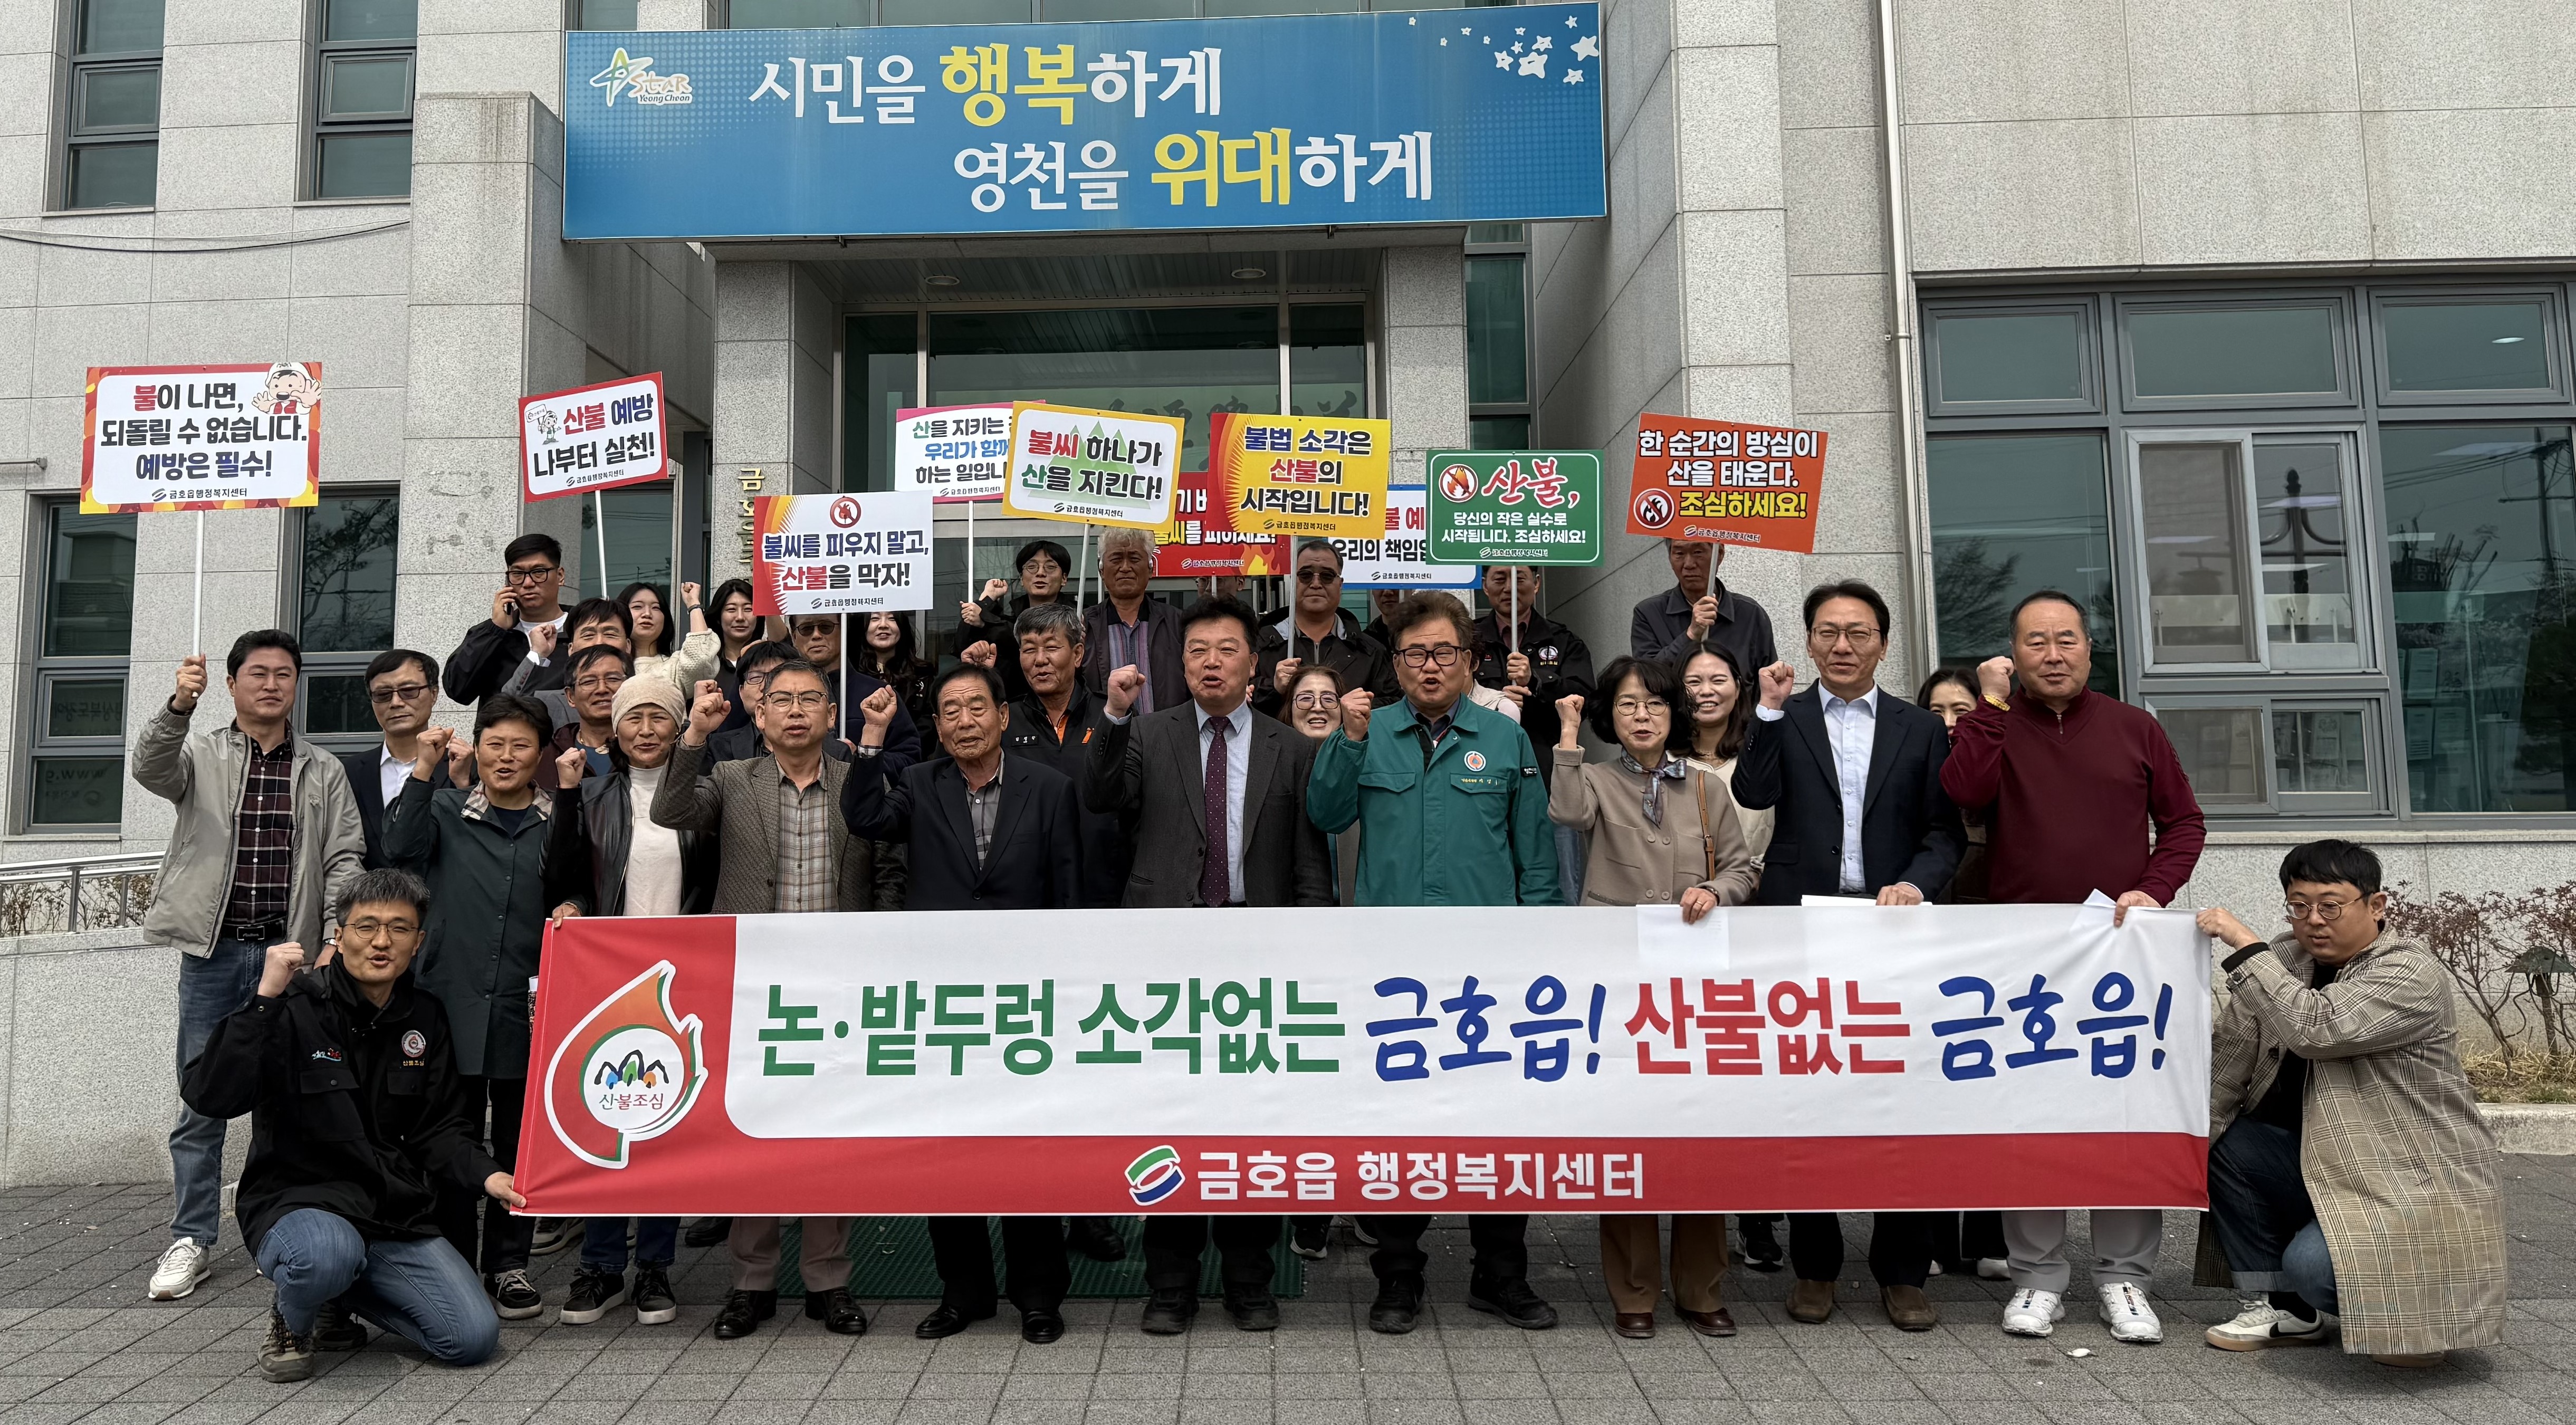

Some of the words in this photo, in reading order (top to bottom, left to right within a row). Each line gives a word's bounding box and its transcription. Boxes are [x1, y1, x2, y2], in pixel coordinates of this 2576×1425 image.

[640, 94, 663, 103] Yeong
[749, 54, 926, 124] 시민을
[940, 42, 1222, 127] 행복하게
[954, 140, 1128, 213] 영천을
[1152, 127, 1432, 206] 위대하게
[134, 384, 180, 411] 불이
[188, 382, 243, 413] 나면,
[563, 403, 606, 435] 산불
[611, 394, 654, 426] 예방
[913, 420, 947, 438] 산을
[952, 417, 1004, 436] 지키는
[101, 418, 171, 446] 되돌릴
[177, 418, 199, 445] 수
[206, 415, 307, 444] 없습니다.
[1245, 426, 1291, 451] 불법
[1299, 429, 1371, 455] 소각은
[1640, 431, 1664, 456] 한
[1669, 431, 1738, 457] 순간의
[1746, 431, 1817, 457] 방심이
[534, 441, 597, 476] 나부터
[605, 432, 655, 465] 실천!
[925, 441, 977, 461] 우리가
[1029, 429, 1079, 458] 불씨
[1087, 436, 1162, 466] 하나가
[136, 452, 209, 481] 예방은
[216, 451, 272, 479] 필수!
[916, 466, 951, 483] 하는
[956, 461, 1008, 482] 일입니
[1270, 459, 1342, 484] 산불의
[1668, 460, 1713, 486] 산을
[1721, 461, 1799, 487] 태운다.
[1021, 464, 1071, 492] 산을
[1078, 470, 1163, 500] 지킨다!
[1483, 457, 1580, 509] 산불,
[1241, 487, 1368, 516] 시작입니다!
[1679, 492, 1807, 518] 조심하세요!
[1453, 512, 1492, 526] 당신의
[1497, 512, 1524, 526] 작은
[1527, 512, 1567, 527] 실수로
[763, 533, 821, 559] 불씨를
[826, 532, 881, 557] 피우지
[887, 530, 929, 556] 말고,
[1441, 529, 1511, 544] 시작됩니다.
[1515, 529, 1586, 544] 조심하세요!
[782, 564, 851, 591] 산불을
[858, 563, 909, 588] 막자!
[757, 978, 1055, 1076] 논·밭두렁
[1075, 977, 1345, 1075] 소각없는
[1365, 973, 1607, 1084] 금호읍!
[1625, 976, 1911, 1077] 산불없는
[1931, 971, 2173, 1083] 금호읍!
[599, 1093, 664, 1110] 산불조심
[1197, 1150, 1337, 1202] 금호읍
[1357, 1151, 1645, 1202] 행정복지센터
